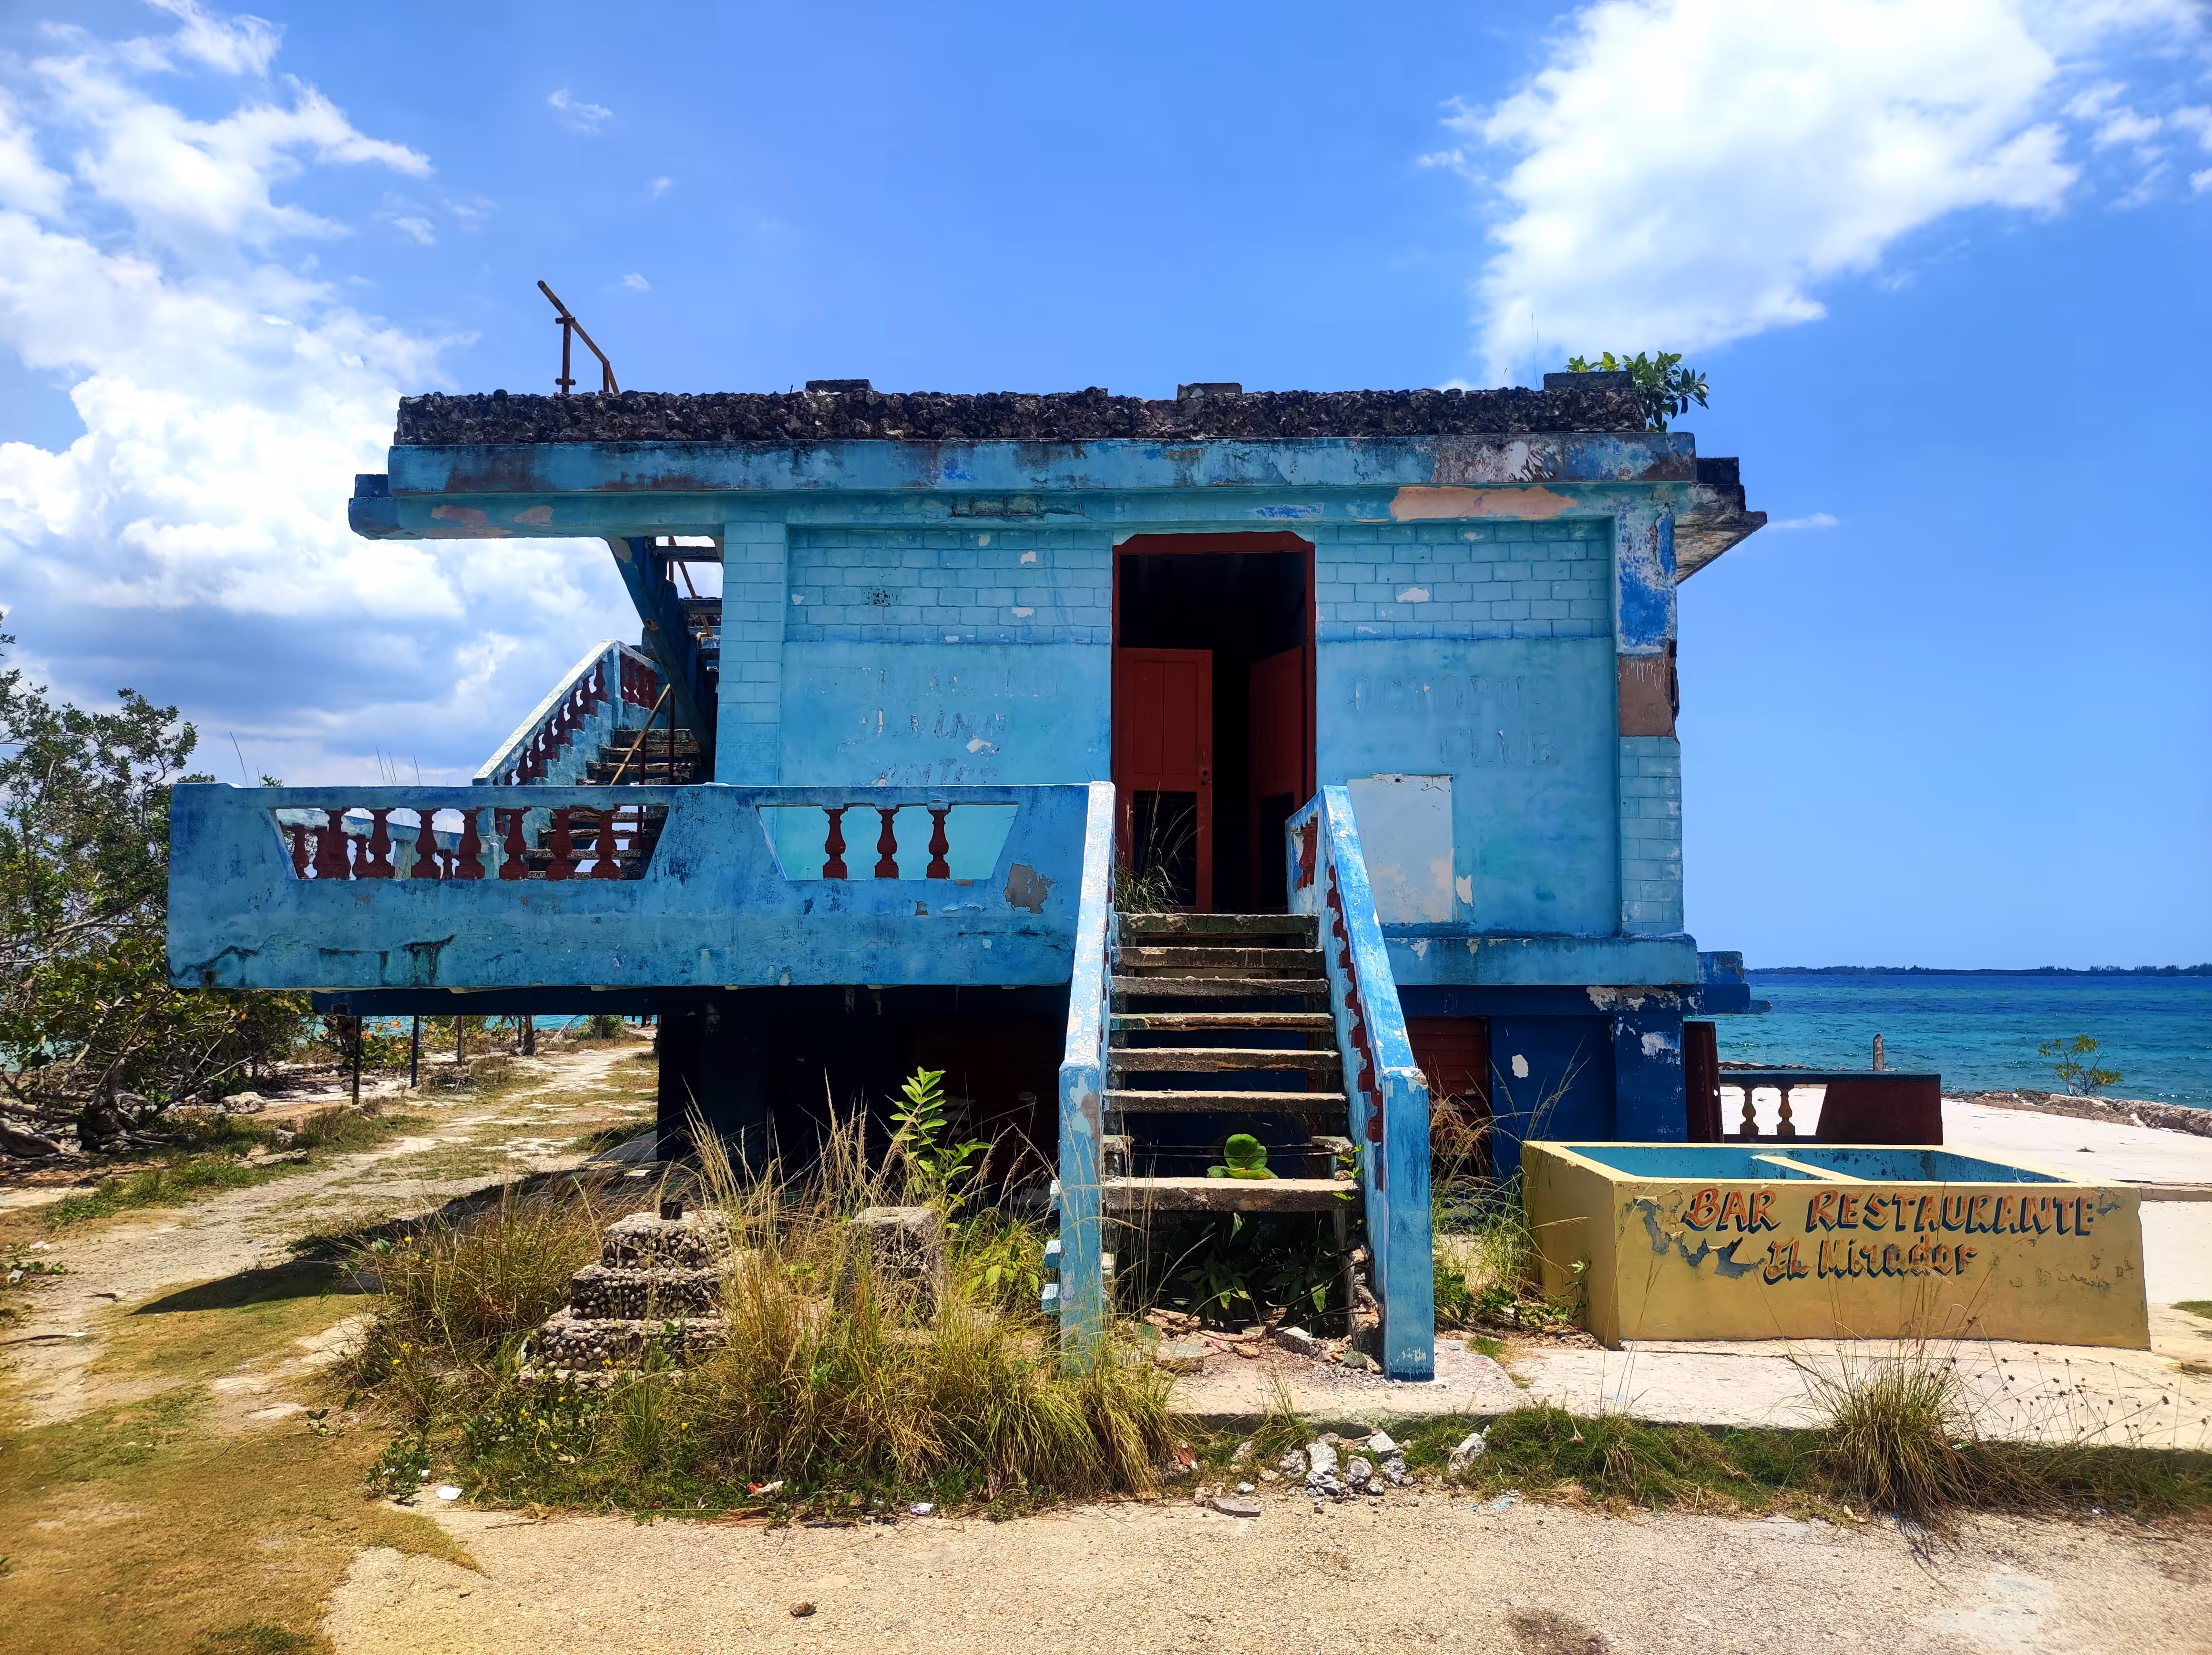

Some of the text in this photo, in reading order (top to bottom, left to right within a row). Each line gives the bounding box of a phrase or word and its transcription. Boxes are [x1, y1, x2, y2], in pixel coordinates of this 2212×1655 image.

[1680, 1188, 2093, 1236] BAR RESTAURANTE
[1817, 1233, 1978, 1279] Mirador
